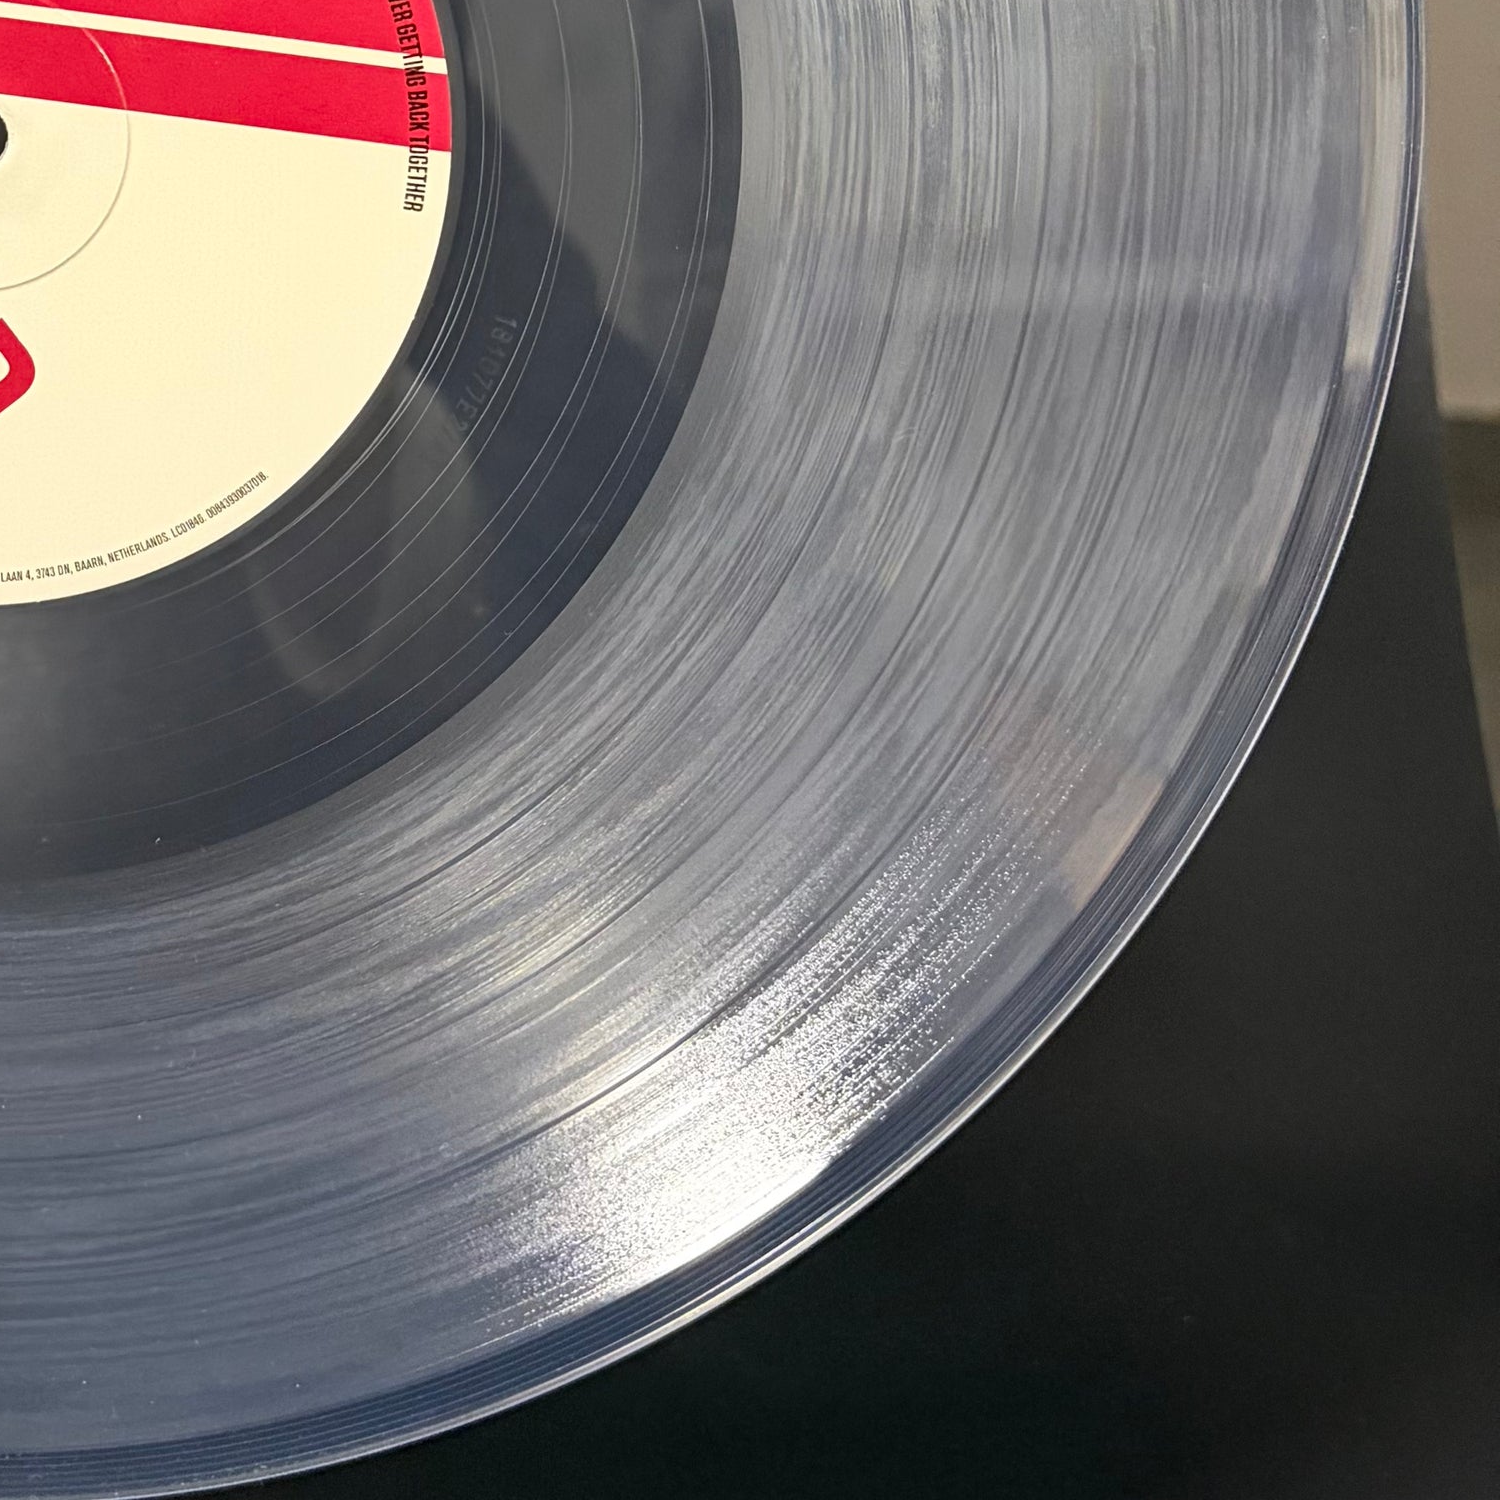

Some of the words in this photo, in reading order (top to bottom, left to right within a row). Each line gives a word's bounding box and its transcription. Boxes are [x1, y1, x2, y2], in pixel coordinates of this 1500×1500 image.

[395, 22, 427, 87] GETTING
[406, 89, 430, 132] BACK
[402, 134, 430, 212] TOGETHER
[34, 565, 56, 579] 3743
[73, 554, 108, 572] BAARN,
[106, 531, 171, 563] NETHERLANDS.
